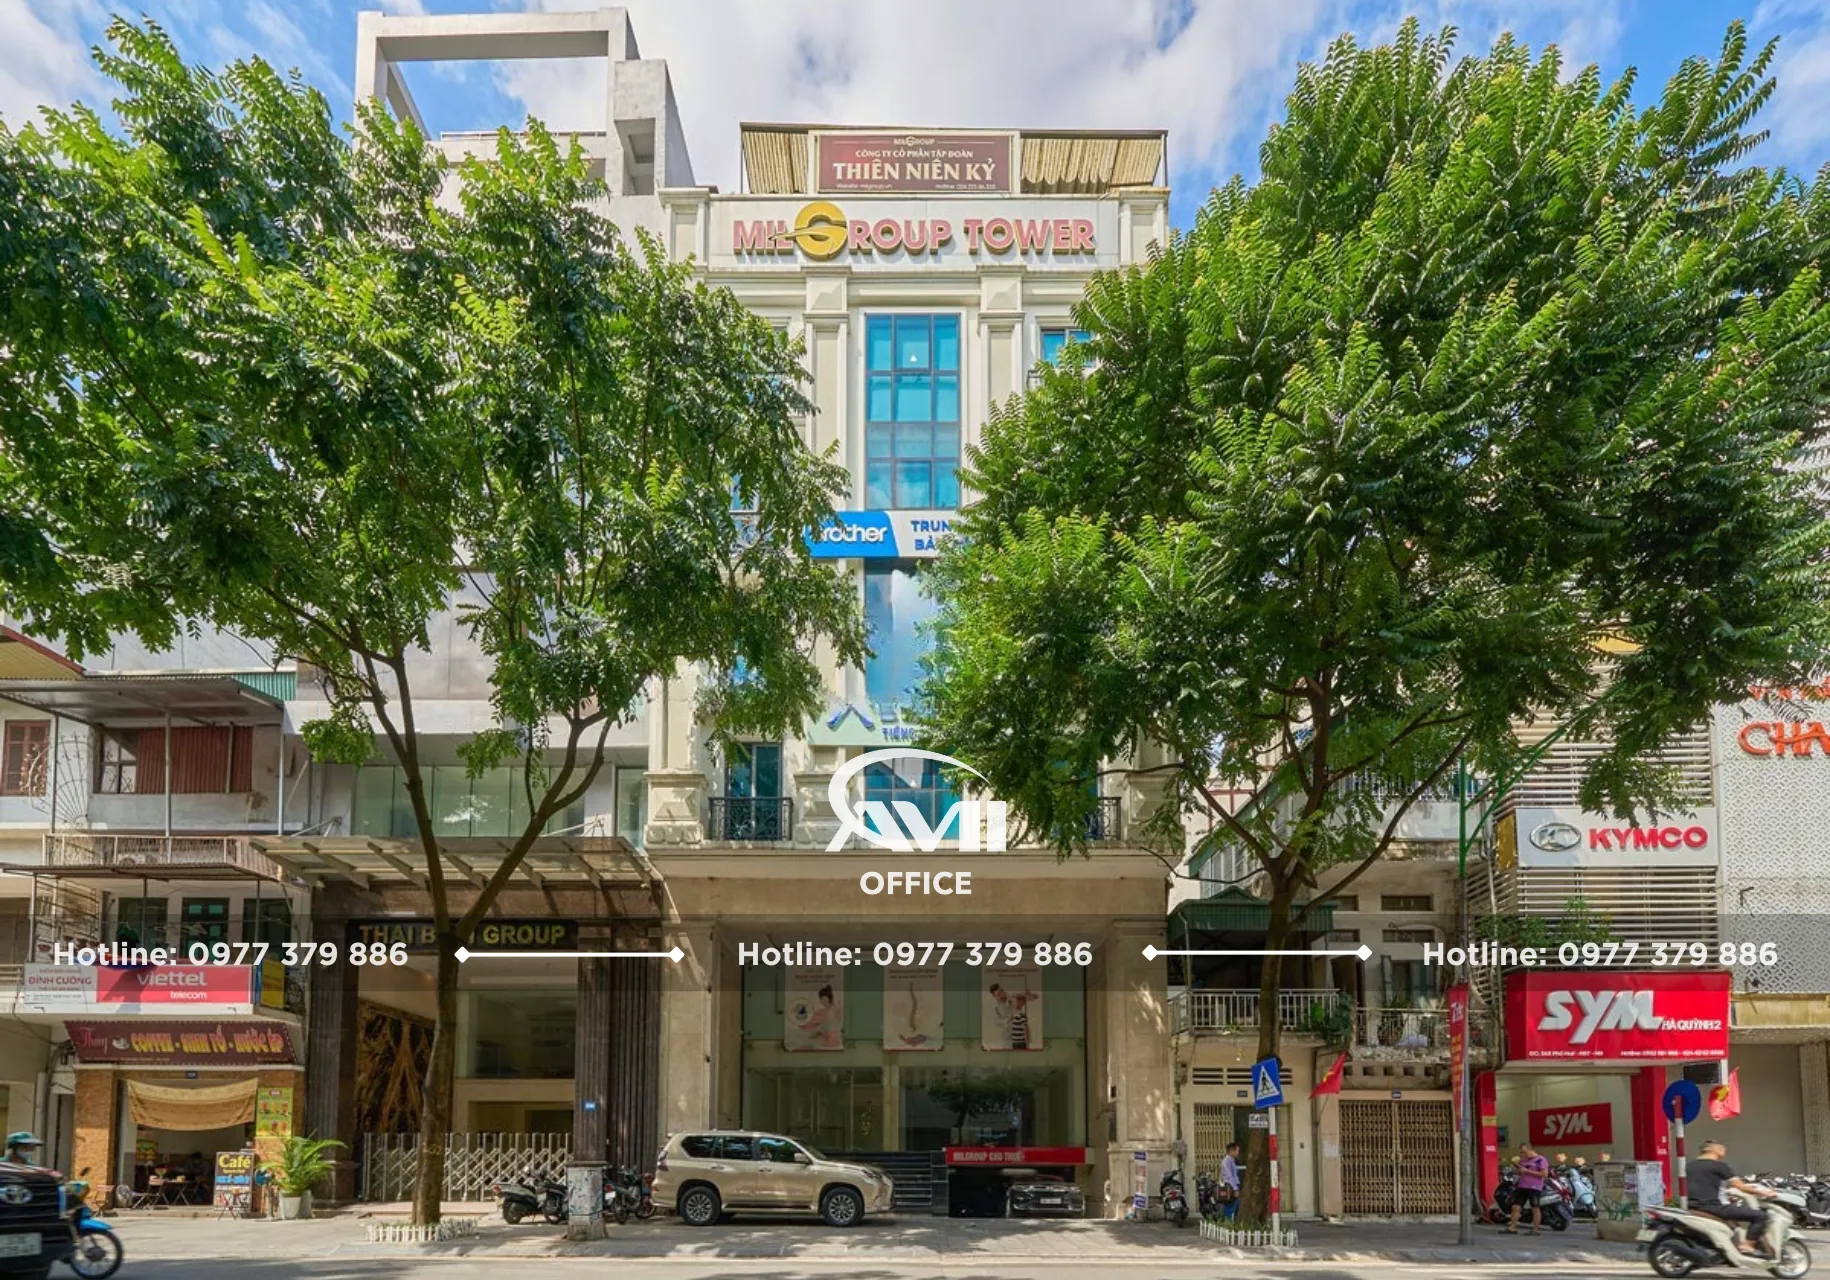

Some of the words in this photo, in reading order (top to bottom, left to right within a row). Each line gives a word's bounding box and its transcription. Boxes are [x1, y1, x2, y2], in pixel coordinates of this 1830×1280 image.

[833, 159, 900, 180] THIÊN
[906, 159, 960, 180] NIÊN
[732, 202, 952, 261] MILGROUP
[963, 216, 1096, 255] TOWER
[809, 523, 888, 543] rother
[911, 520, 956, 534] TRUN
[1589, 826, 1708, 850] KYMCO
[482, 924, 566, 945] GROUP
[136, 971, 207, 987] viettel
[170, 990, 208, 1000] telecom
[1538, 990, 1664, 1044] SYM
[1543, 1112, 1593, 1140] SYM
[218, 1154, 251, 1169] Café
